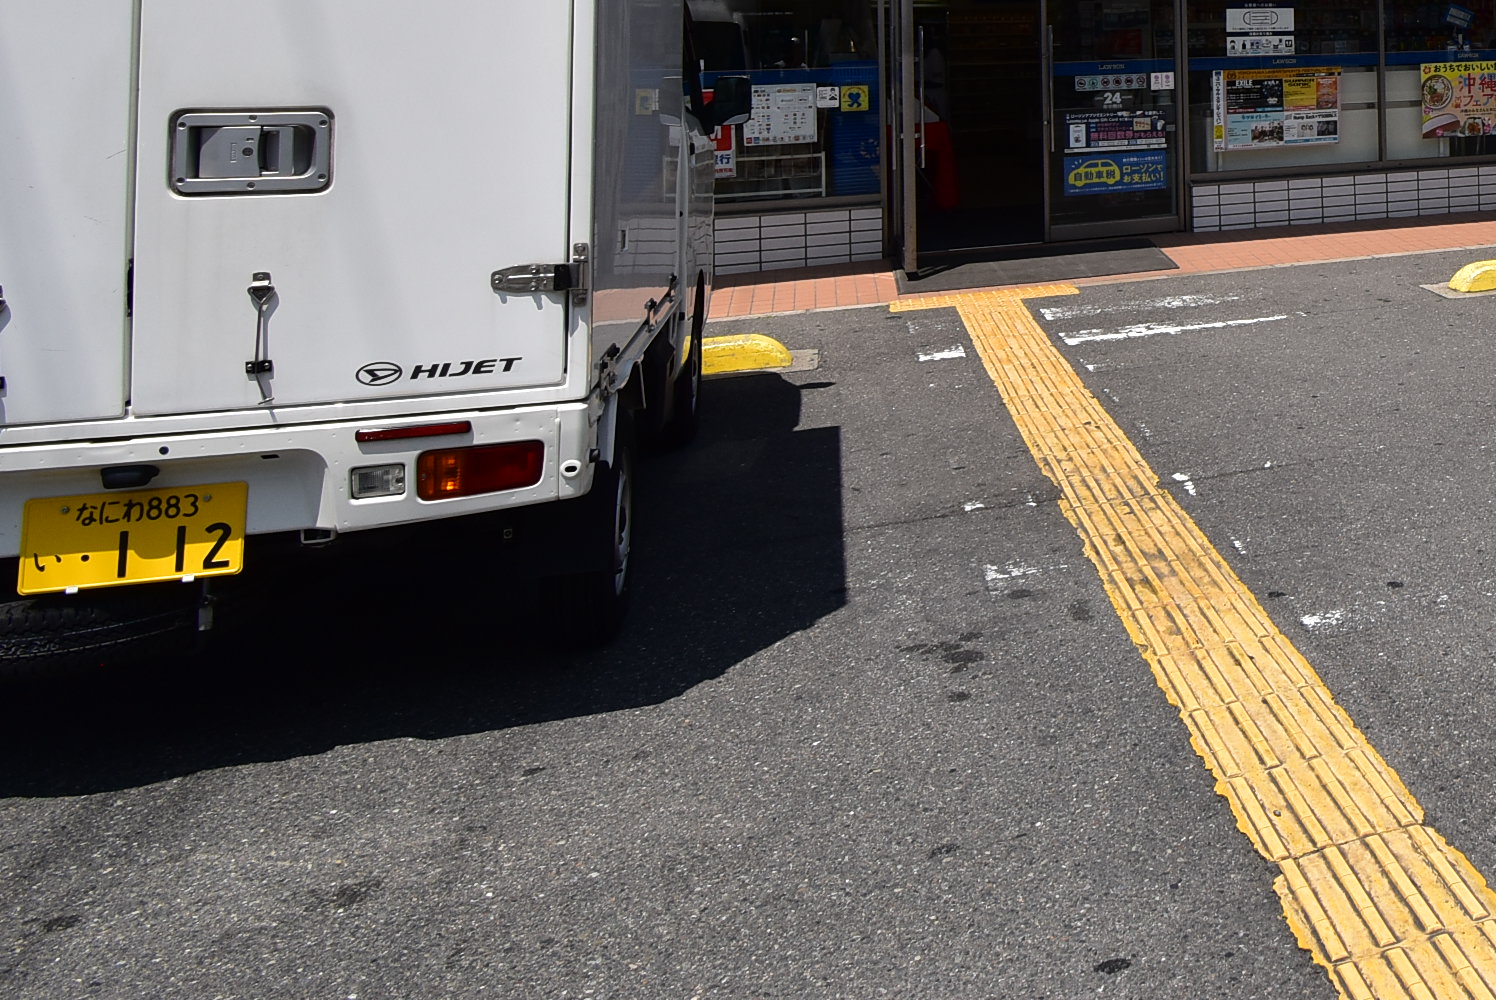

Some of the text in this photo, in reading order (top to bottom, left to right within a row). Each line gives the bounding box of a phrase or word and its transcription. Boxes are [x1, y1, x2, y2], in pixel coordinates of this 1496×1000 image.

[1235, 79, 1253, 87] EXILE
[1103, 92, 1123, 104] 24
[1463, 93, 1494, 107] フェア
[1073, 169, 1116, 182] 自動車税
[409, 356, 523, 380] HIJET
